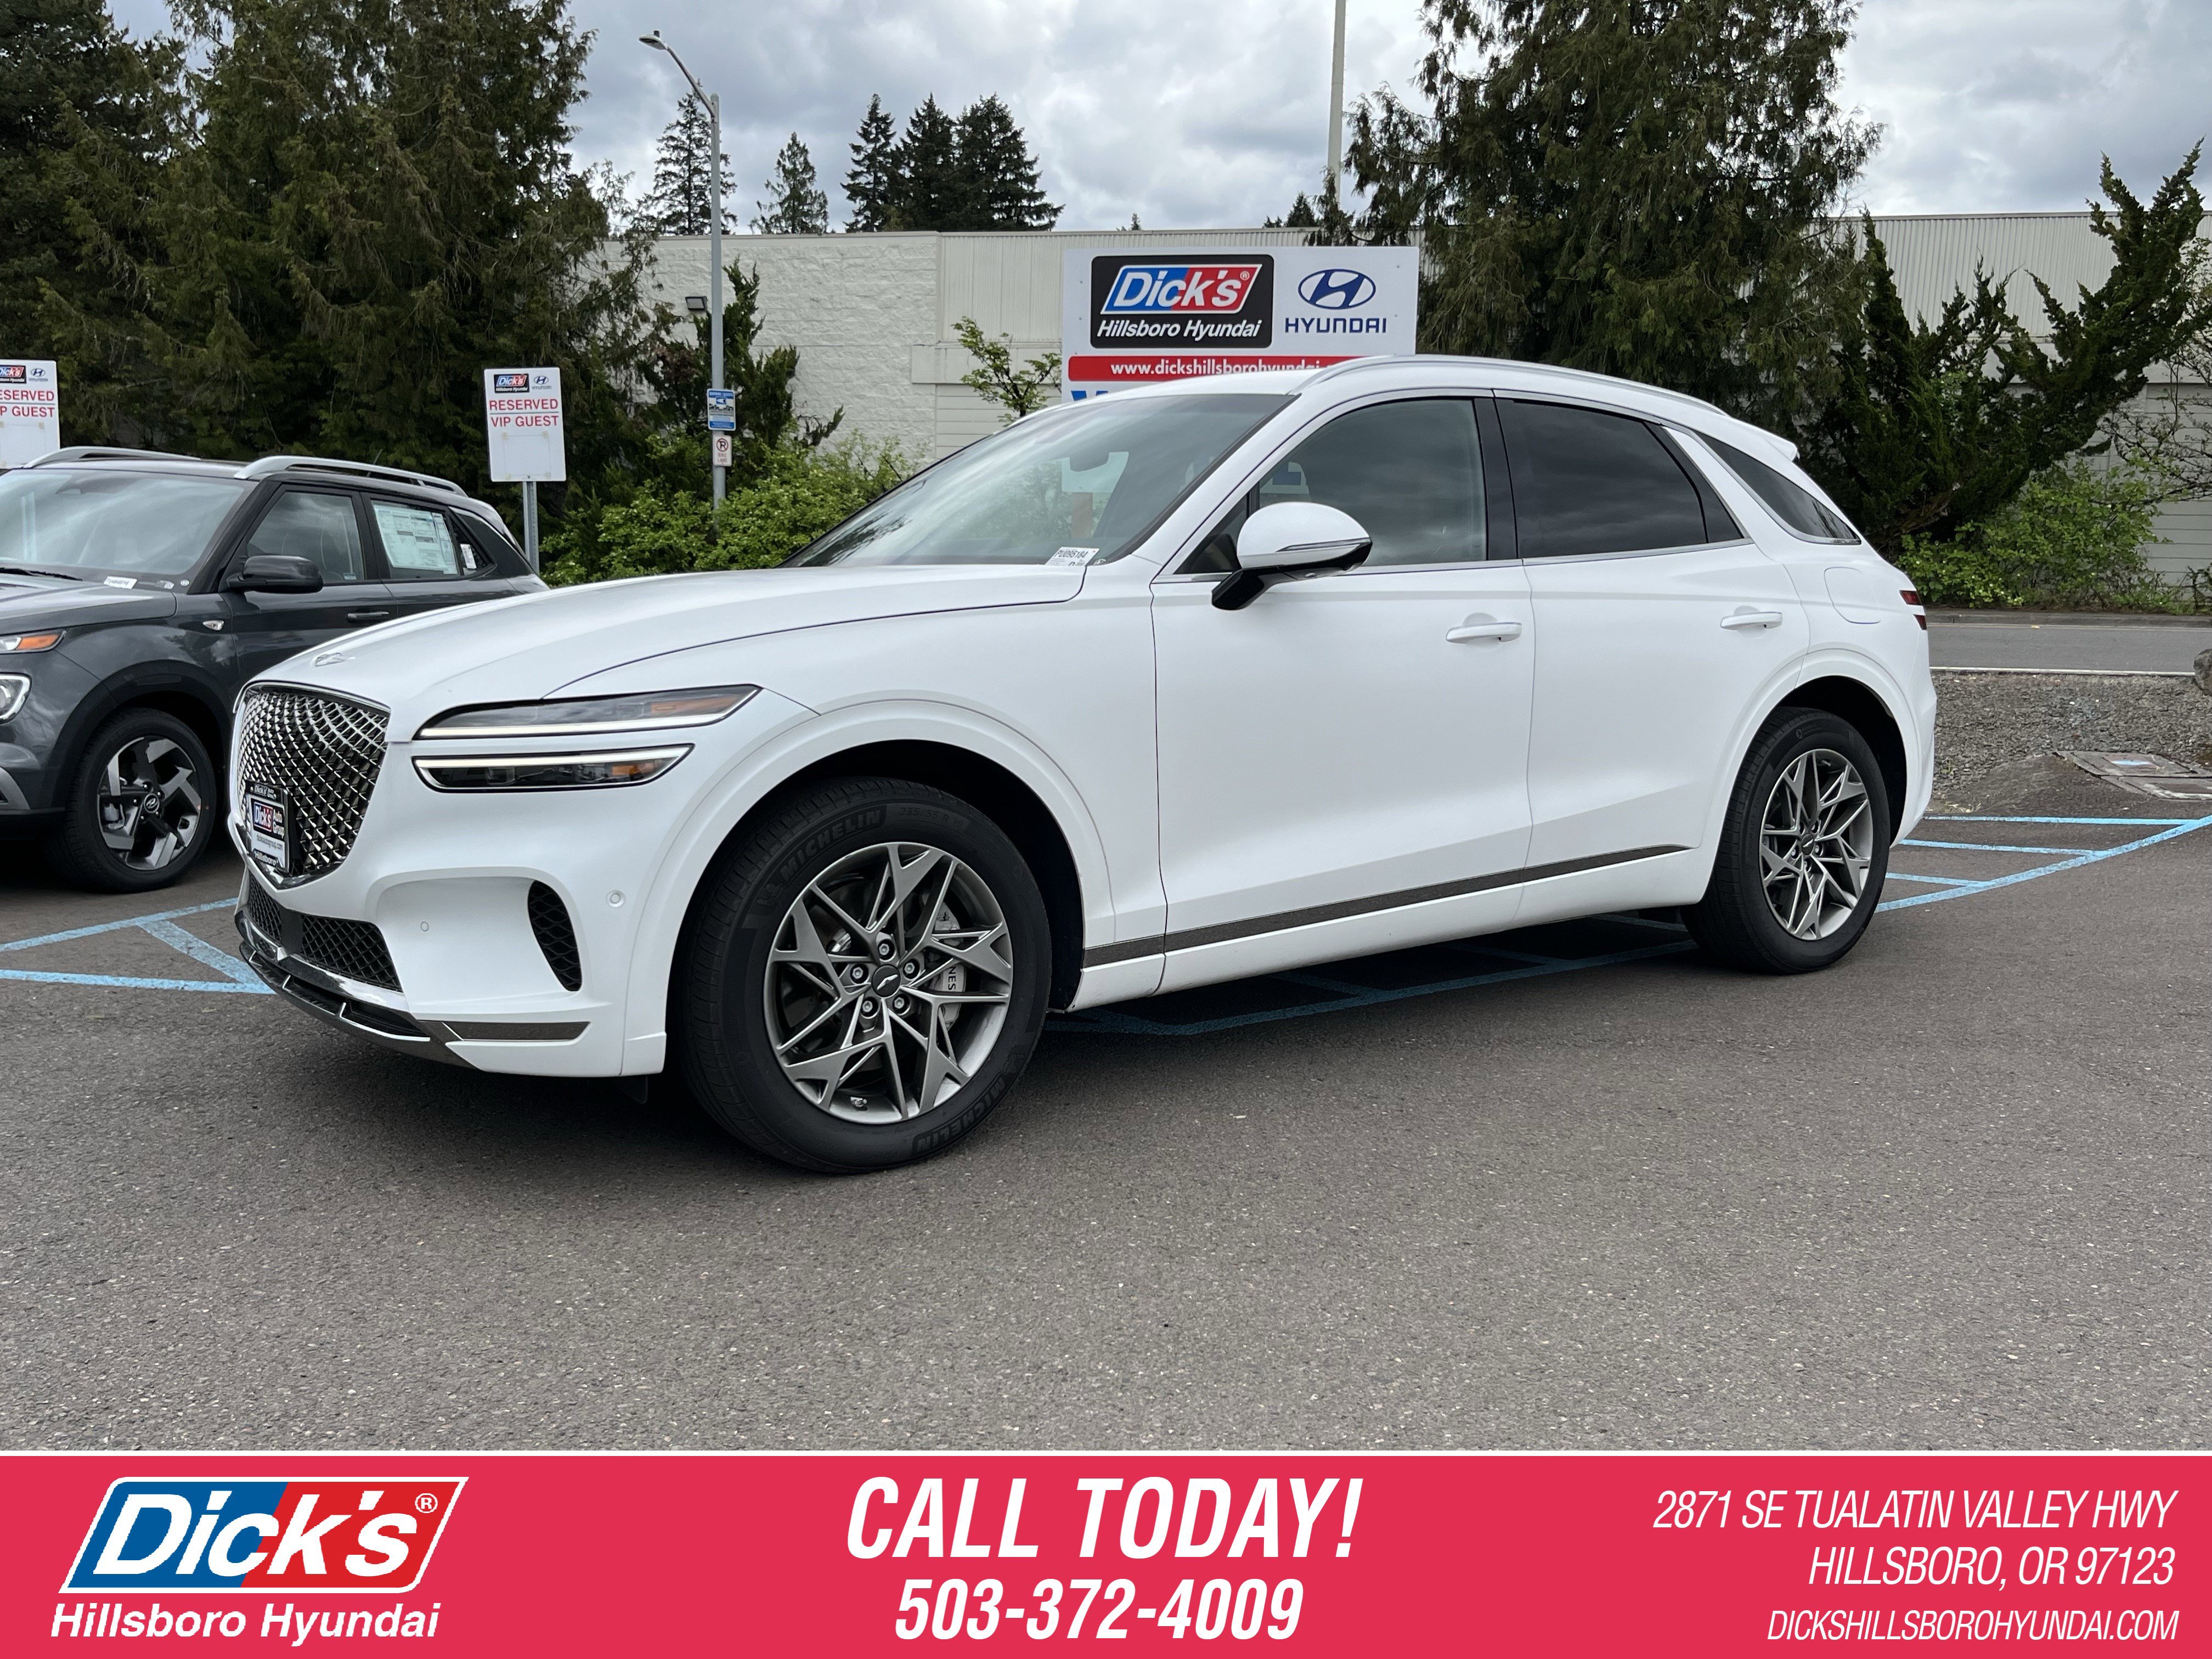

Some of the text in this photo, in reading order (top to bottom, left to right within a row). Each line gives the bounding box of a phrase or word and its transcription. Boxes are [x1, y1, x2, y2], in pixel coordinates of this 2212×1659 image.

[1113, 270, 1242, 307] Dick's
[1097, 320, 1262, 341] Hillsboro Hyundai
[1285, 318, 1386, 334] HYUNDAI
[12, 407, 55, 417] GUEST
[489, 399, 558, 411] RESERVED
[490, 416, 559, 427] VIP GUEST
[255, 805, 272, 828] Dick's
[780, 809, 883, 882] MICHELIN
[917, 1078, 1006, 1151] MICHELIN
